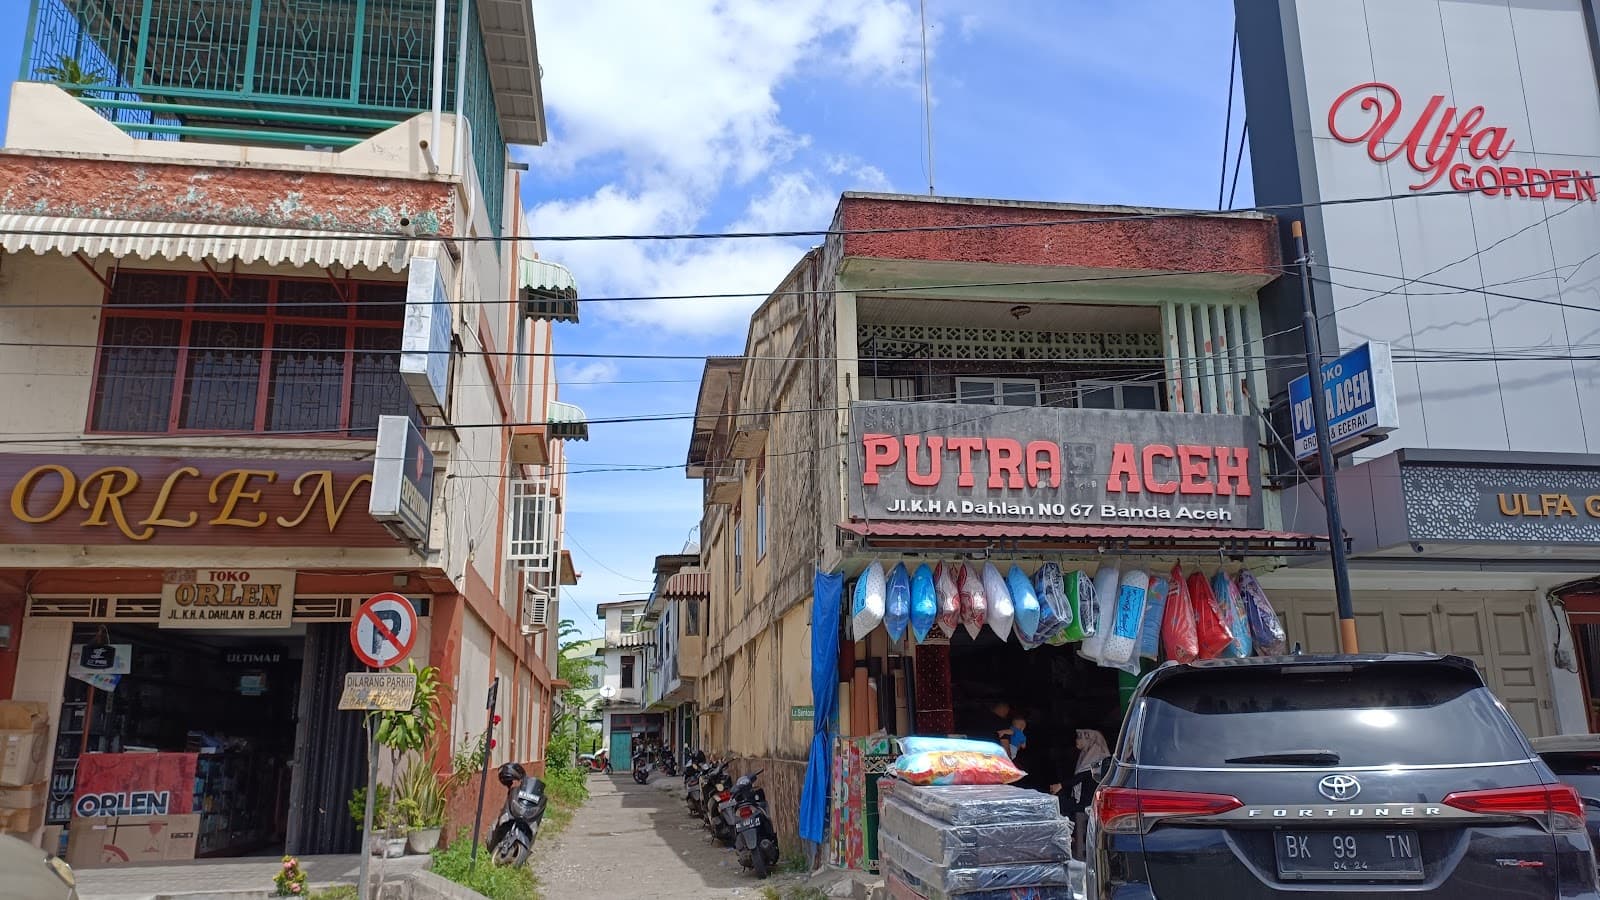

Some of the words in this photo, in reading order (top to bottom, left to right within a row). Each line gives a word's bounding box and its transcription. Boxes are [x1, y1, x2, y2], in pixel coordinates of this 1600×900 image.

[1328, 82, 1516, 191] Ulfa
[1449, 163, 1598, 201] GORDEN
[1335, 370, 1371, 416] ACEH
[1338, 413, 1368, 436] ECERAN
[863, 433, 1060, 489] PUTRA
[1106, 443, 1251, 496] ACEH
[10, 464, 372, 541] ORLEN
[945, 501, 958, 513] A
[961, 501, 1034, 516] Dahlan
[1038, 503, 1066, 516] NO
[1070, 504, 1094, 517] 67
[1101, 505, 1171, 519] Banda
[1175, 506, 1232, 520] Aceh
[1498, 493, 1579, 516] ULFA
[208, 571, 251, 582] TOKO
[175, 583, 281, 607] ORLEN
[227, 654, 271, 663] ULTIMA
[347, 676, 385, 688] DILARANG
[386, 677, 415, 689] PARKIR
[76, 791, 170, 817] ORLEN
[1249, 806, 1442, 817] FORTUNER
[1285, 836, 1312, 859] BK
[1332, 835, 1357, 859] 99
[1386, 835, 1413, 859] TN
[1333, 861, 1347, 870] 04
[1354, 861, 1368, 870] 24
